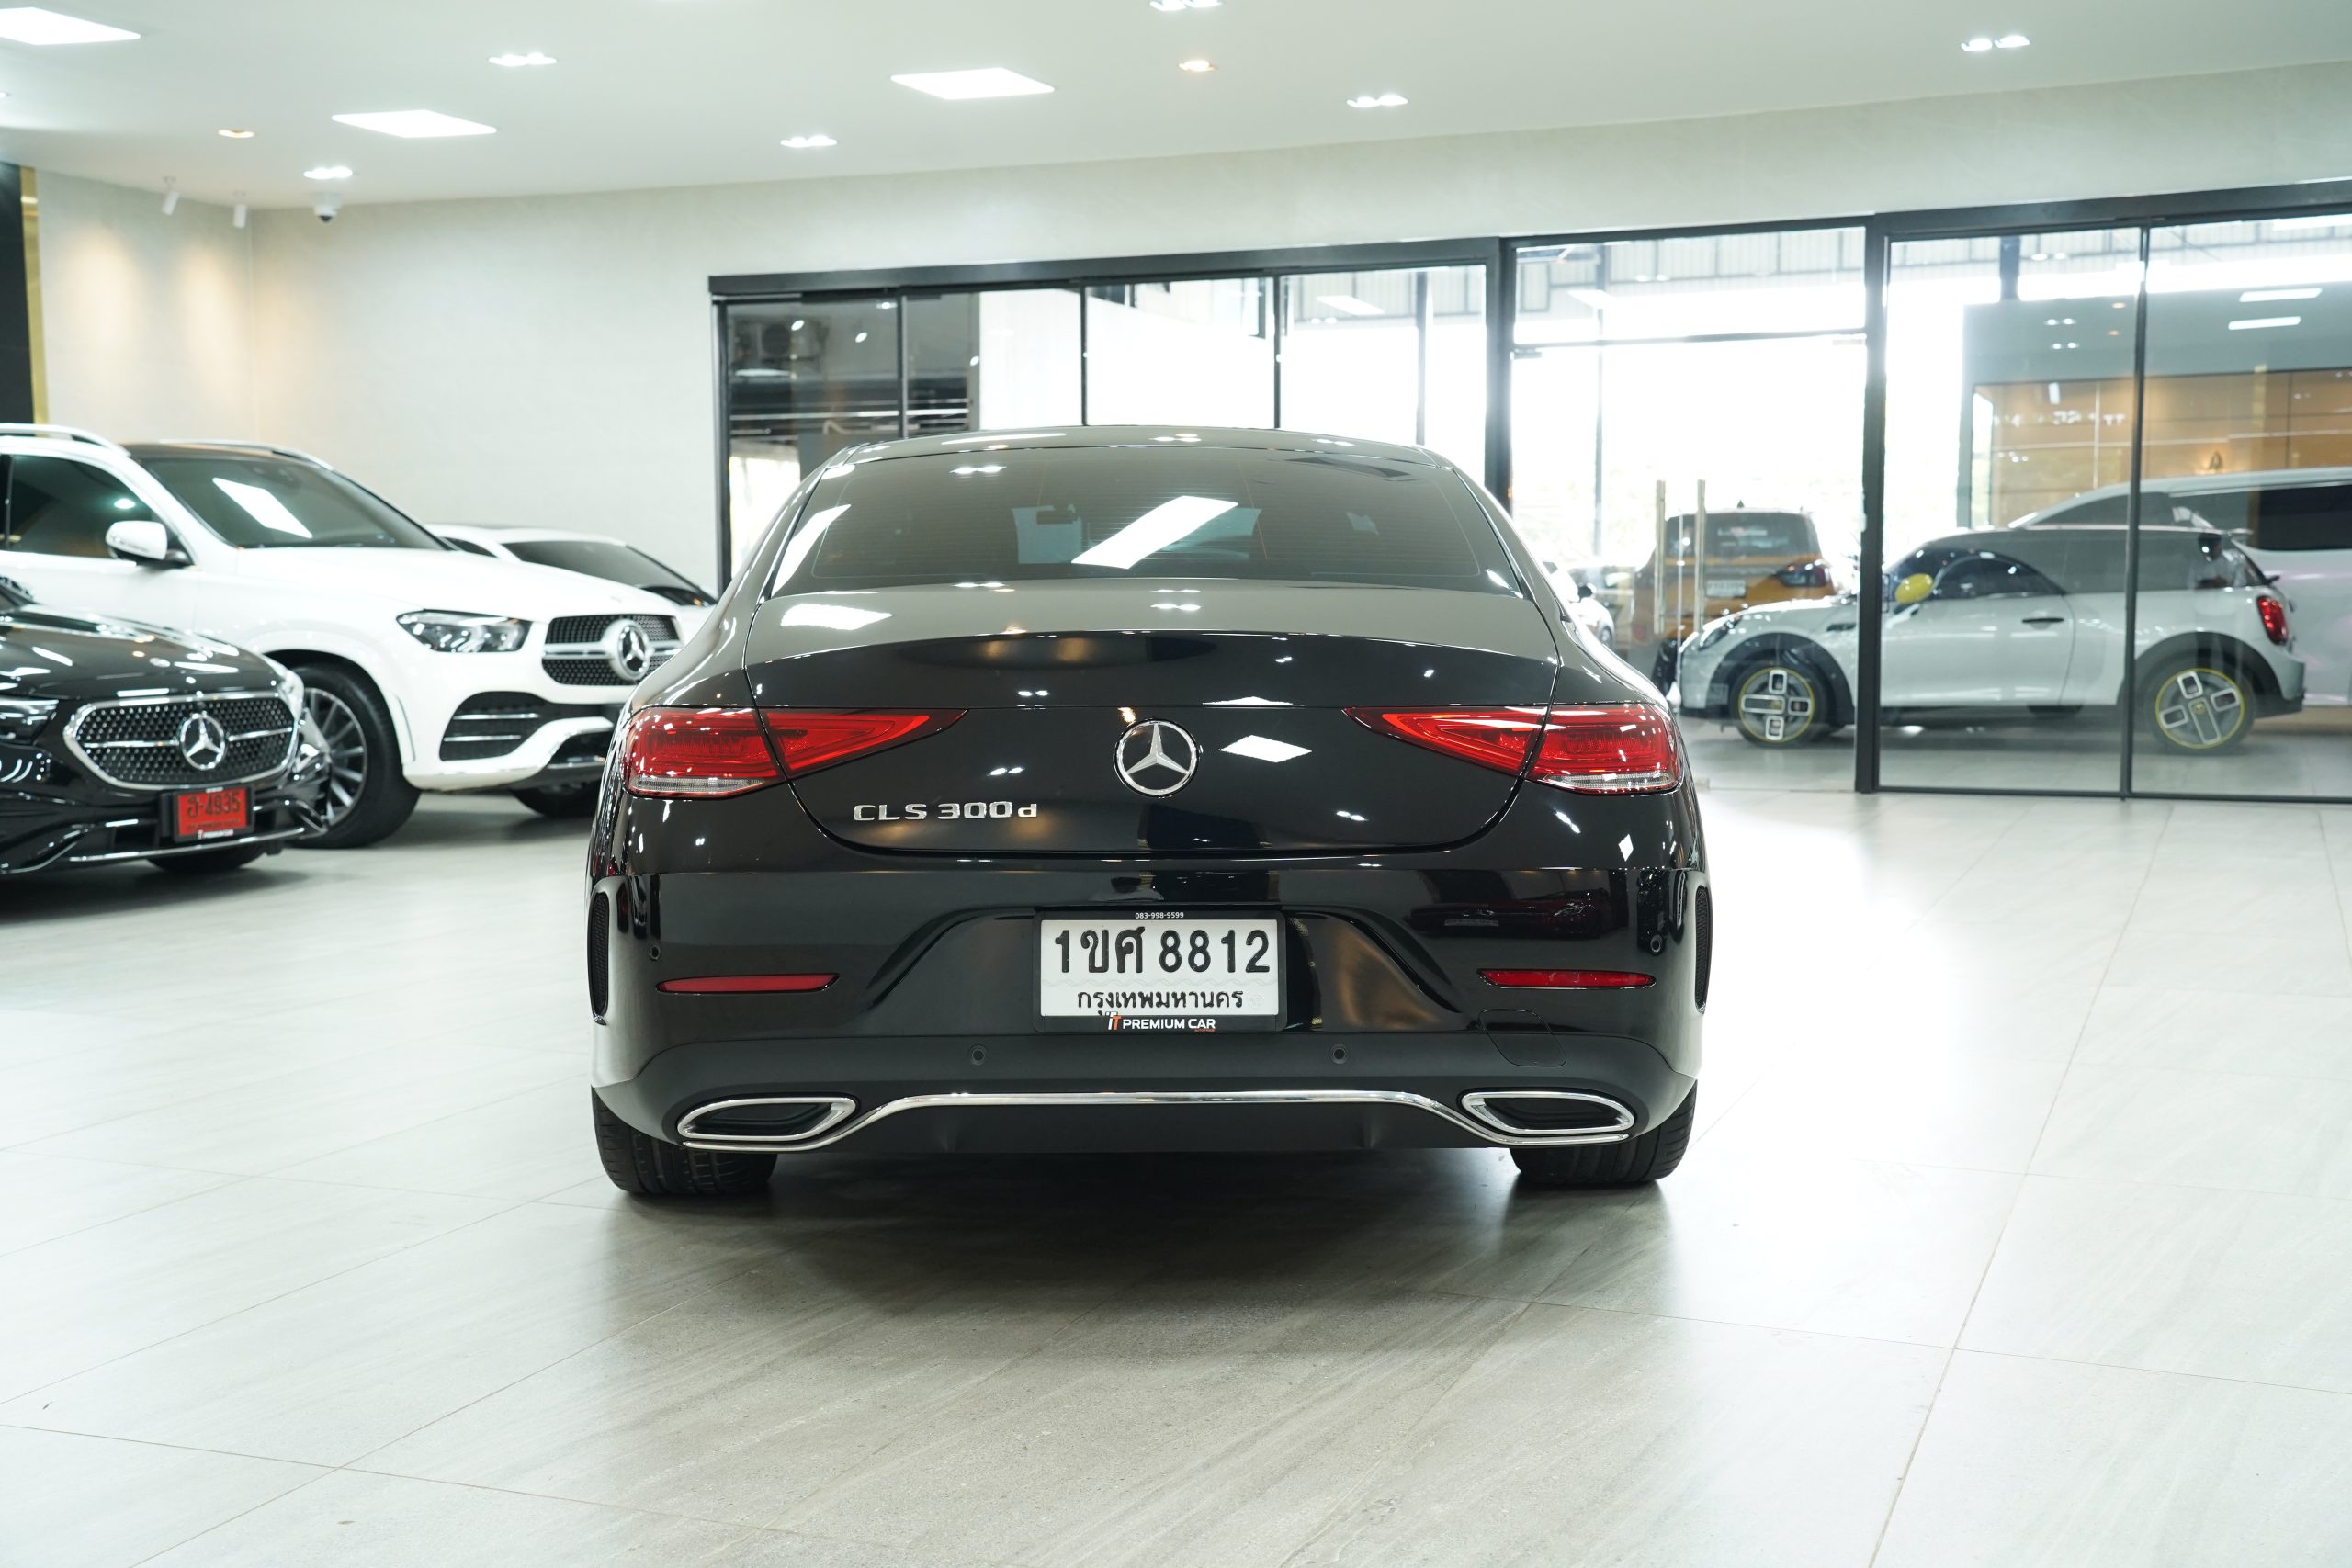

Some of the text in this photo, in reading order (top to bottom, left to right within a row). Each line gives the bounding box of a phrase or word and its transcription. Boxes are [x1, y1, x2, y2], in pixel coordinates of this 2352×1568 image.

[854, 801, 1037, 820] CLS 300d
[1135, 911, 1184, 919] 083-998-9599
[1055, 926, 1271, 974] 1ขศ 8812
[1077, 990, 1244, 1017] กรุงเทพมหานคร
[1122, 1019, 1185, 1030] PREMIUM
[1187, 1018, 1216, 1030] CAR
